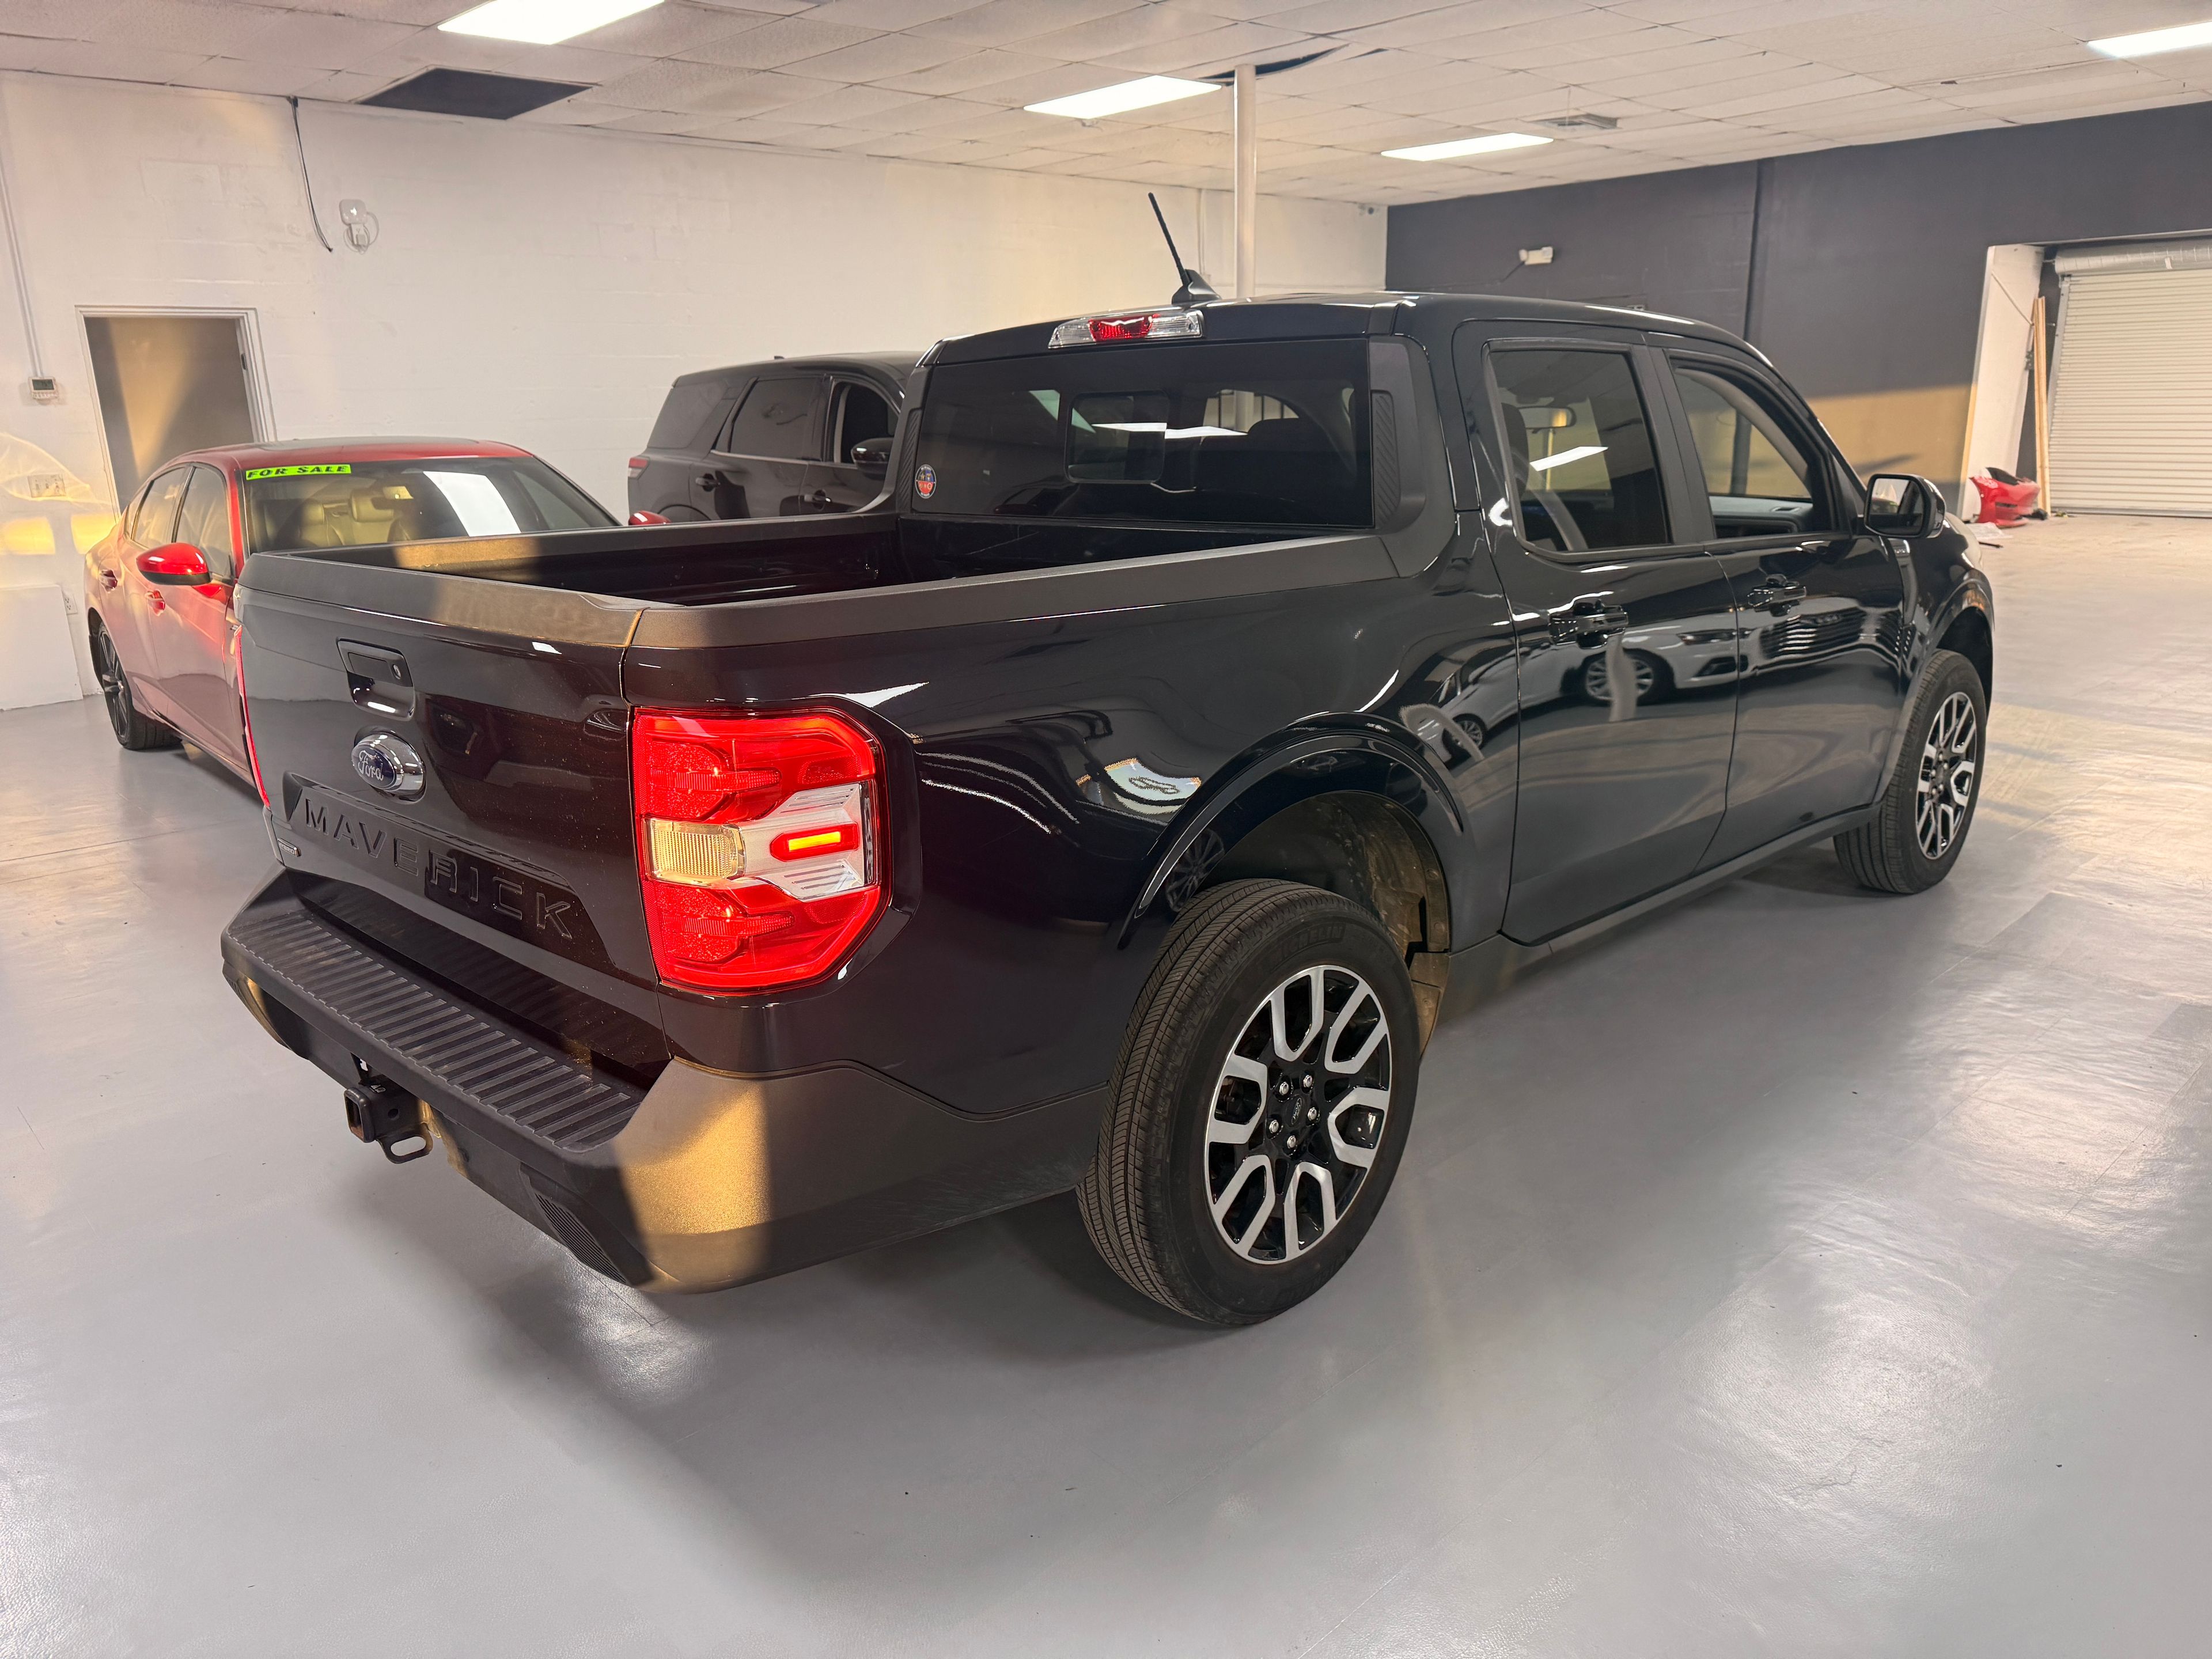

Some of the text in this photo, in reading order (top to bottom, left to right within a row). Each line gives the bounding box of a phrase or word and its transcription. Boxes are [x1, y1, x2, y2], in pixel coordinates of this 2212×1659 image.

[247, 468, 287, 478] FOR
[358, 750, 384, 781] Ford
[305, 798, 572, 940] MAVERICK
